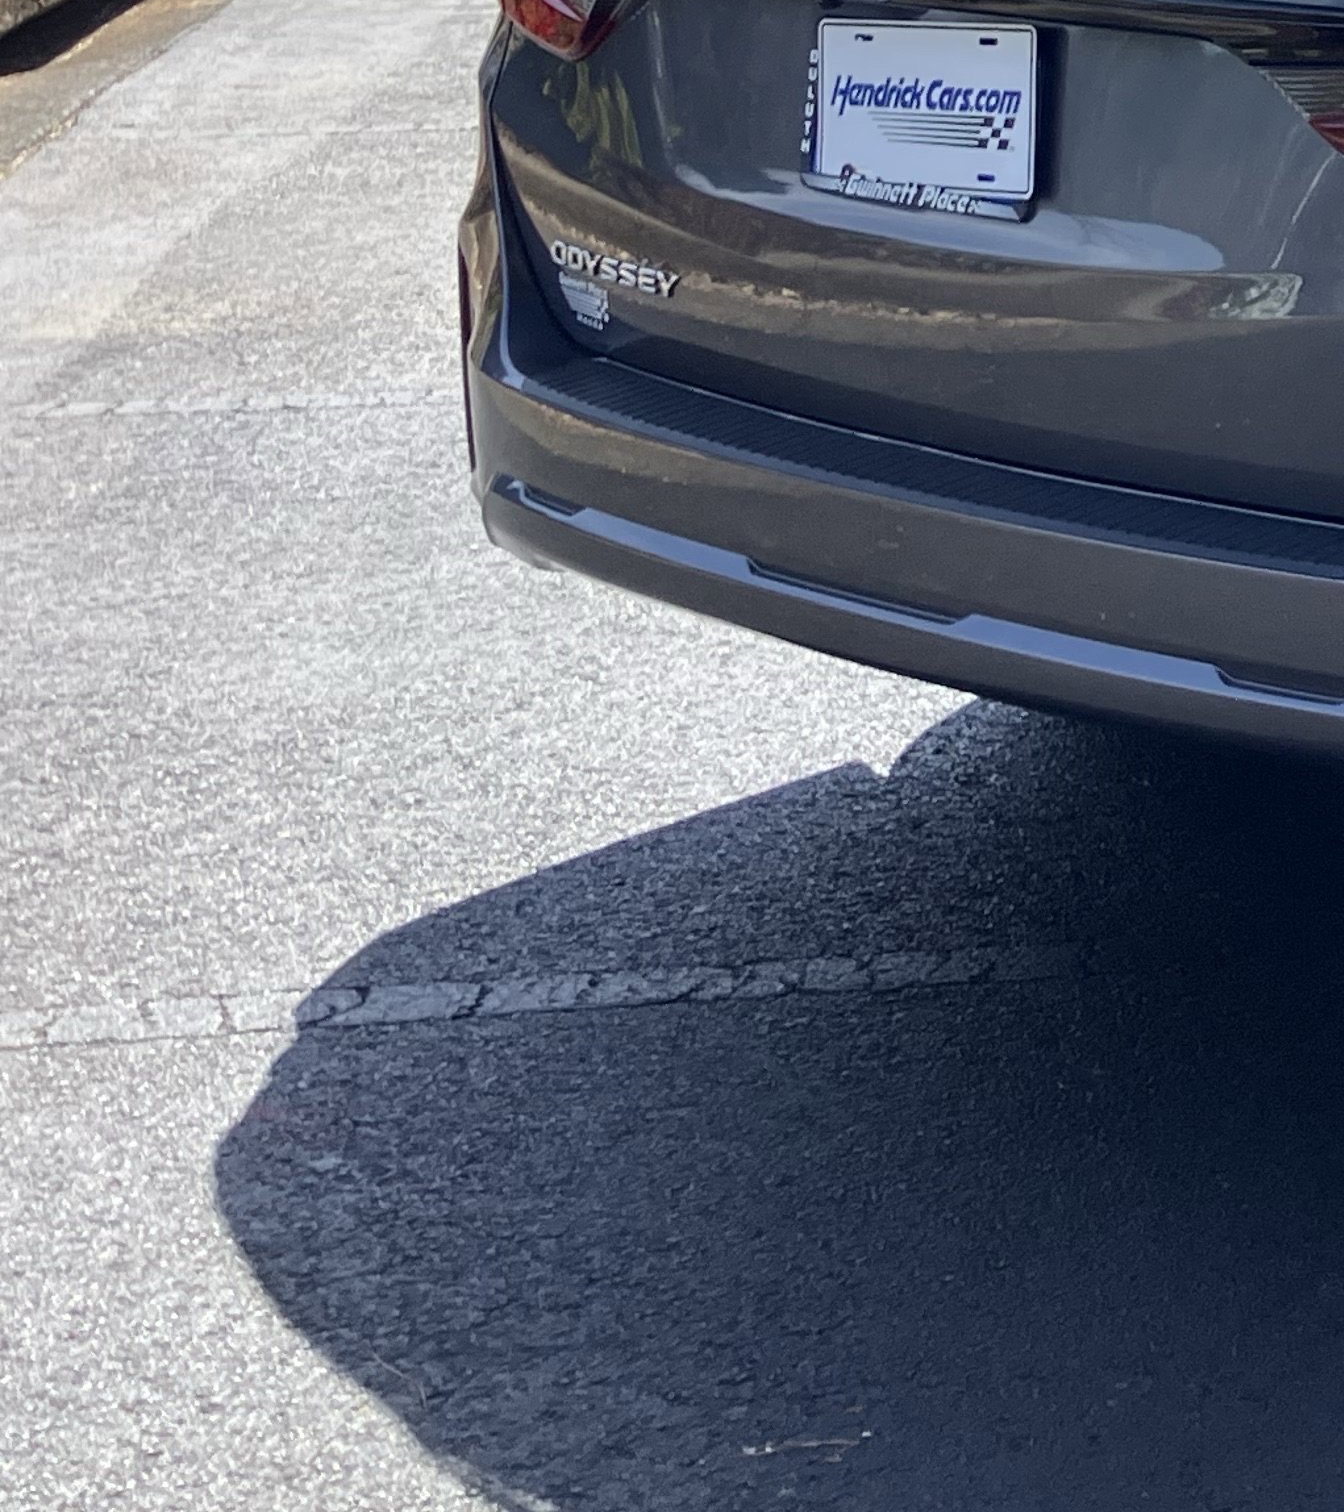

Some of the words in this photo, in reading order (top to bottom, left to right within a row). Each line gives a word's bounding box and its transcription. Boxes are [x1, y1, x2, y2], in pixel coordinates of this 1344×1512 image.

[846, 173, 919, 205] Gwinnett
[918, 184, 970, 213] Place
[551, 240, 680, 297] ODYSSEY
